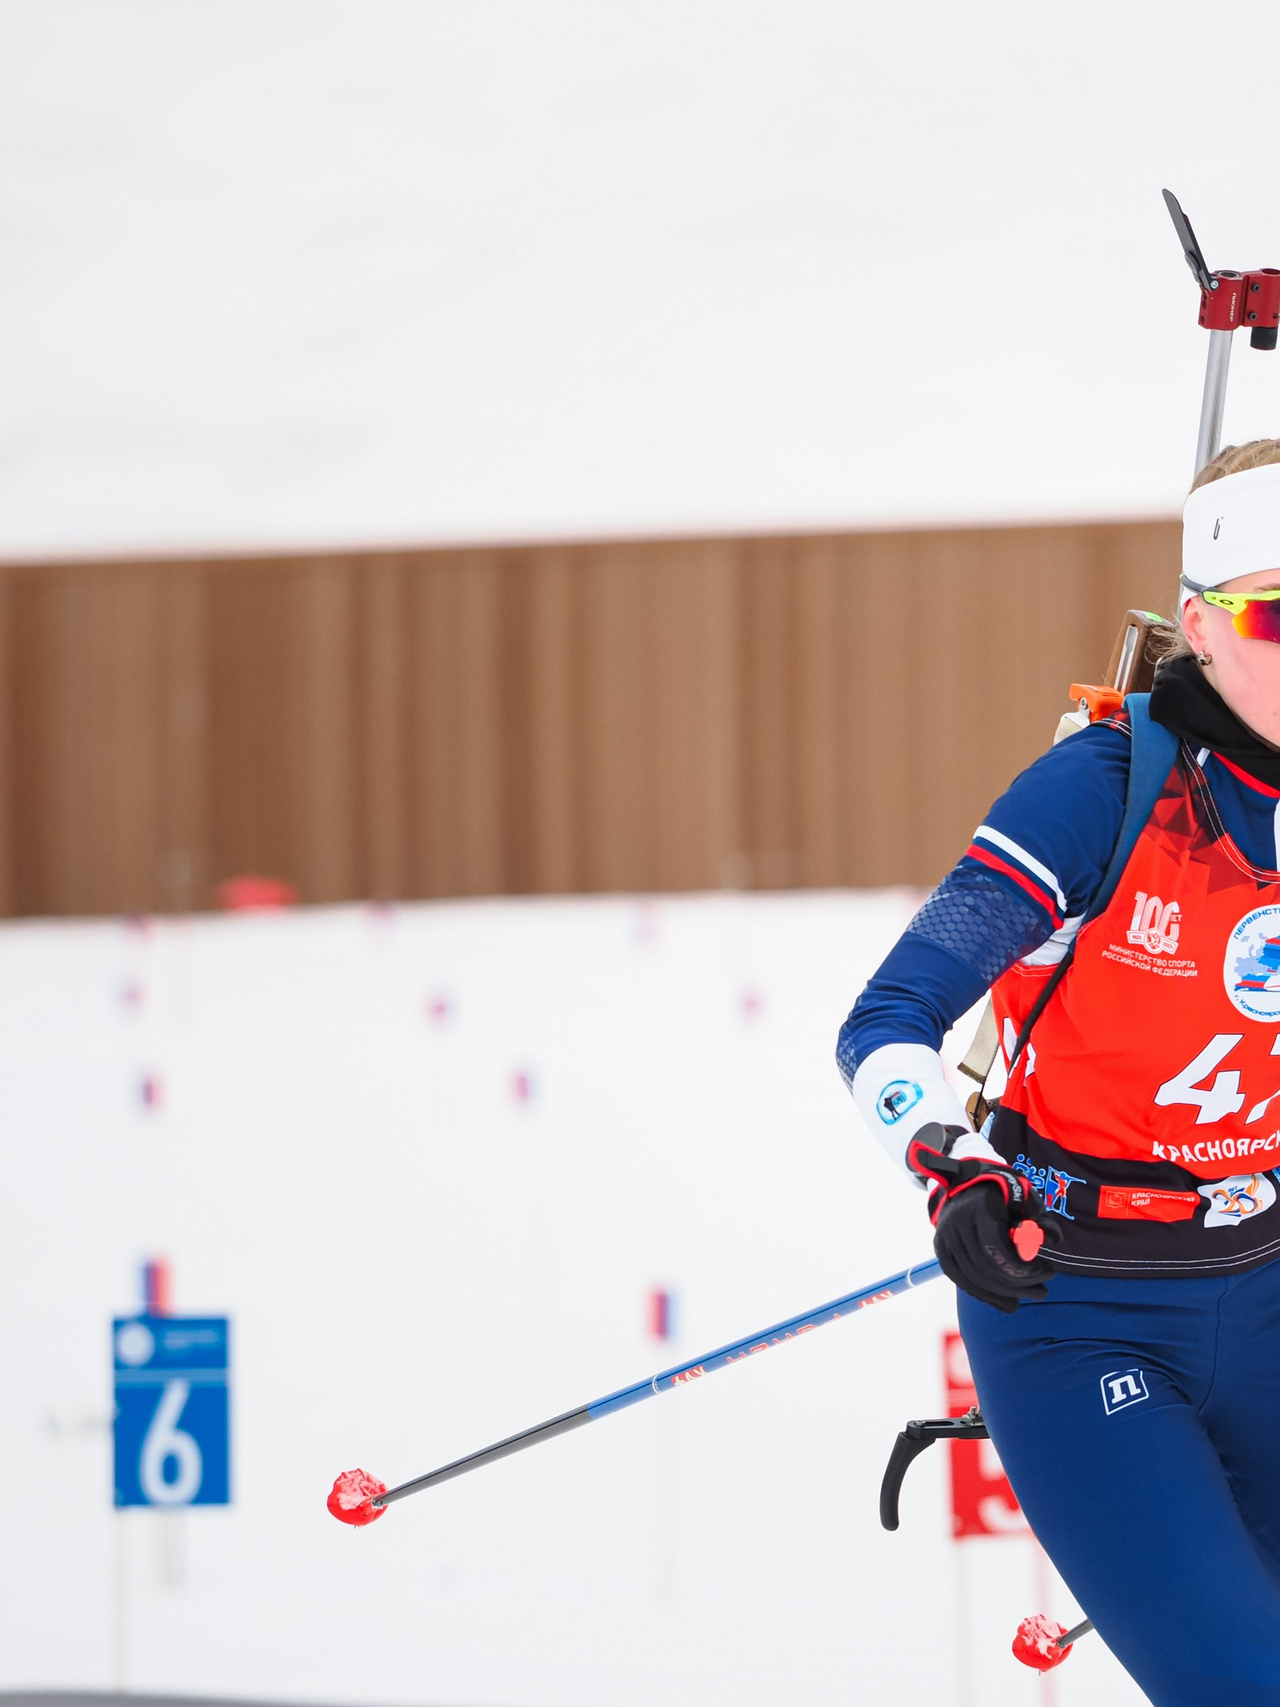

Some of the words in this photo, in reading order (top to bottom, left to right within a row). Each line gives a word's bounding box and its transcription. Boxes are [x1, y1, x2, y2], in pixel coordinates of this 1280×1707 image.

[1102, 950, 1151, 972] РОССИЙСКОЙ
[1152, 964, 1198, 978] ФЕДЕРАЦИИ
[1109, 943, 1167, 967] МИНИСТЕРСТВО
[1168, 960, 1196, 968] СПОРТА
[138, 1378, 204, 1505] 6
